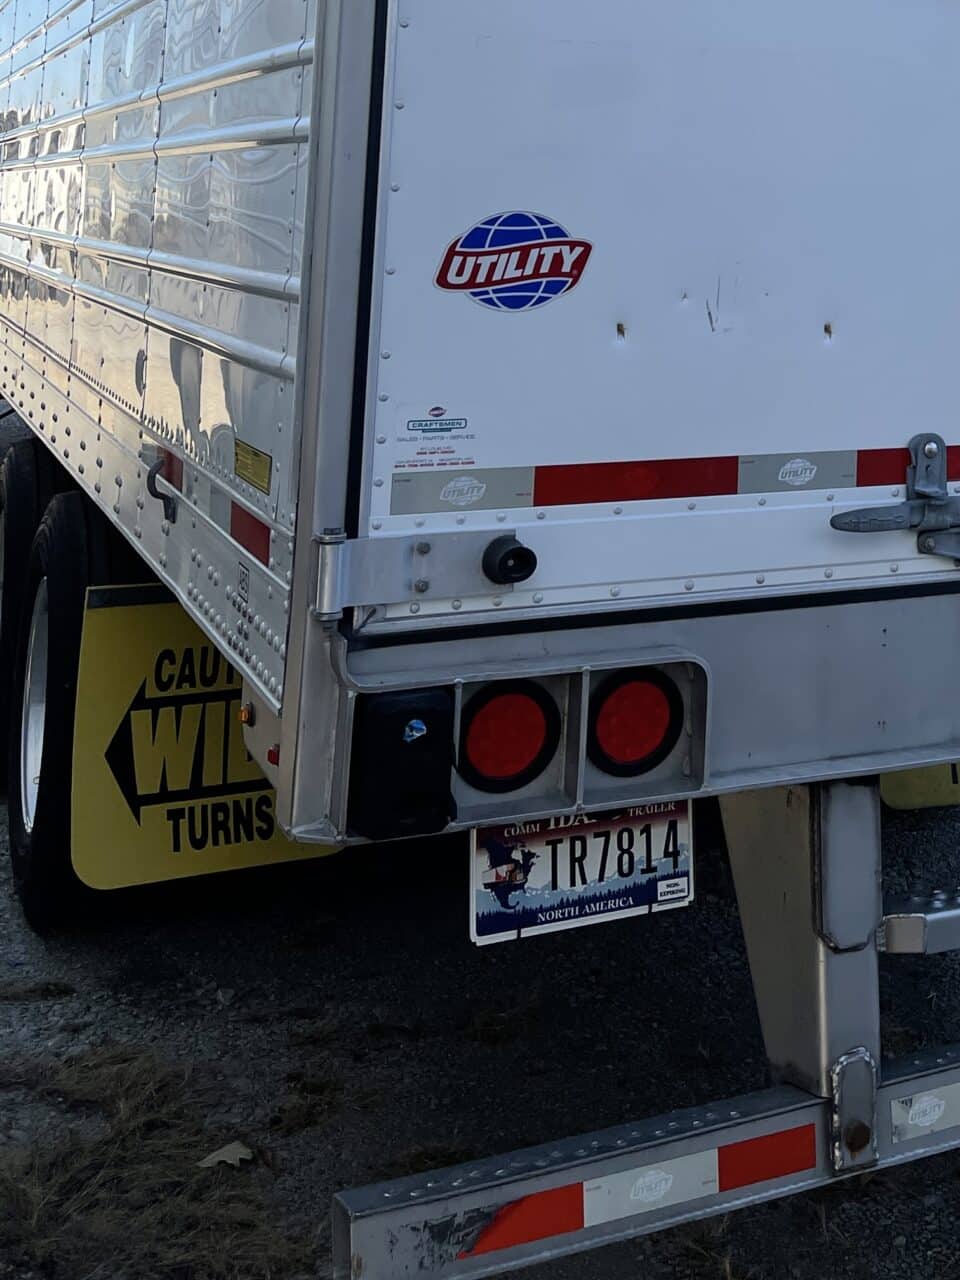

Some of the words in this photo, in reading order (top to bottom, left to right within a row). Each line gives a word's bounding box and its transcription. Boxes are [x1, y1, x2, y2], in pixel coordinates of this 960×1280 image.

[446, 245, 585, 285] UTILITY
[412, 421, 462, 429] CRAFTSMEN
[780, 467, 816, 480] UTILITY
[443, 484, 484, 499] UTILITY
[166, 795, 275, 852] TURNS
[504, 823, 540, 838] COMM
[628, 802, 677, 817] TRAILER
[545, 820, 681, 891] TR7814
[537, 908, 580, 923] NORTH
[582, 896, 634, 915] AMERICA
